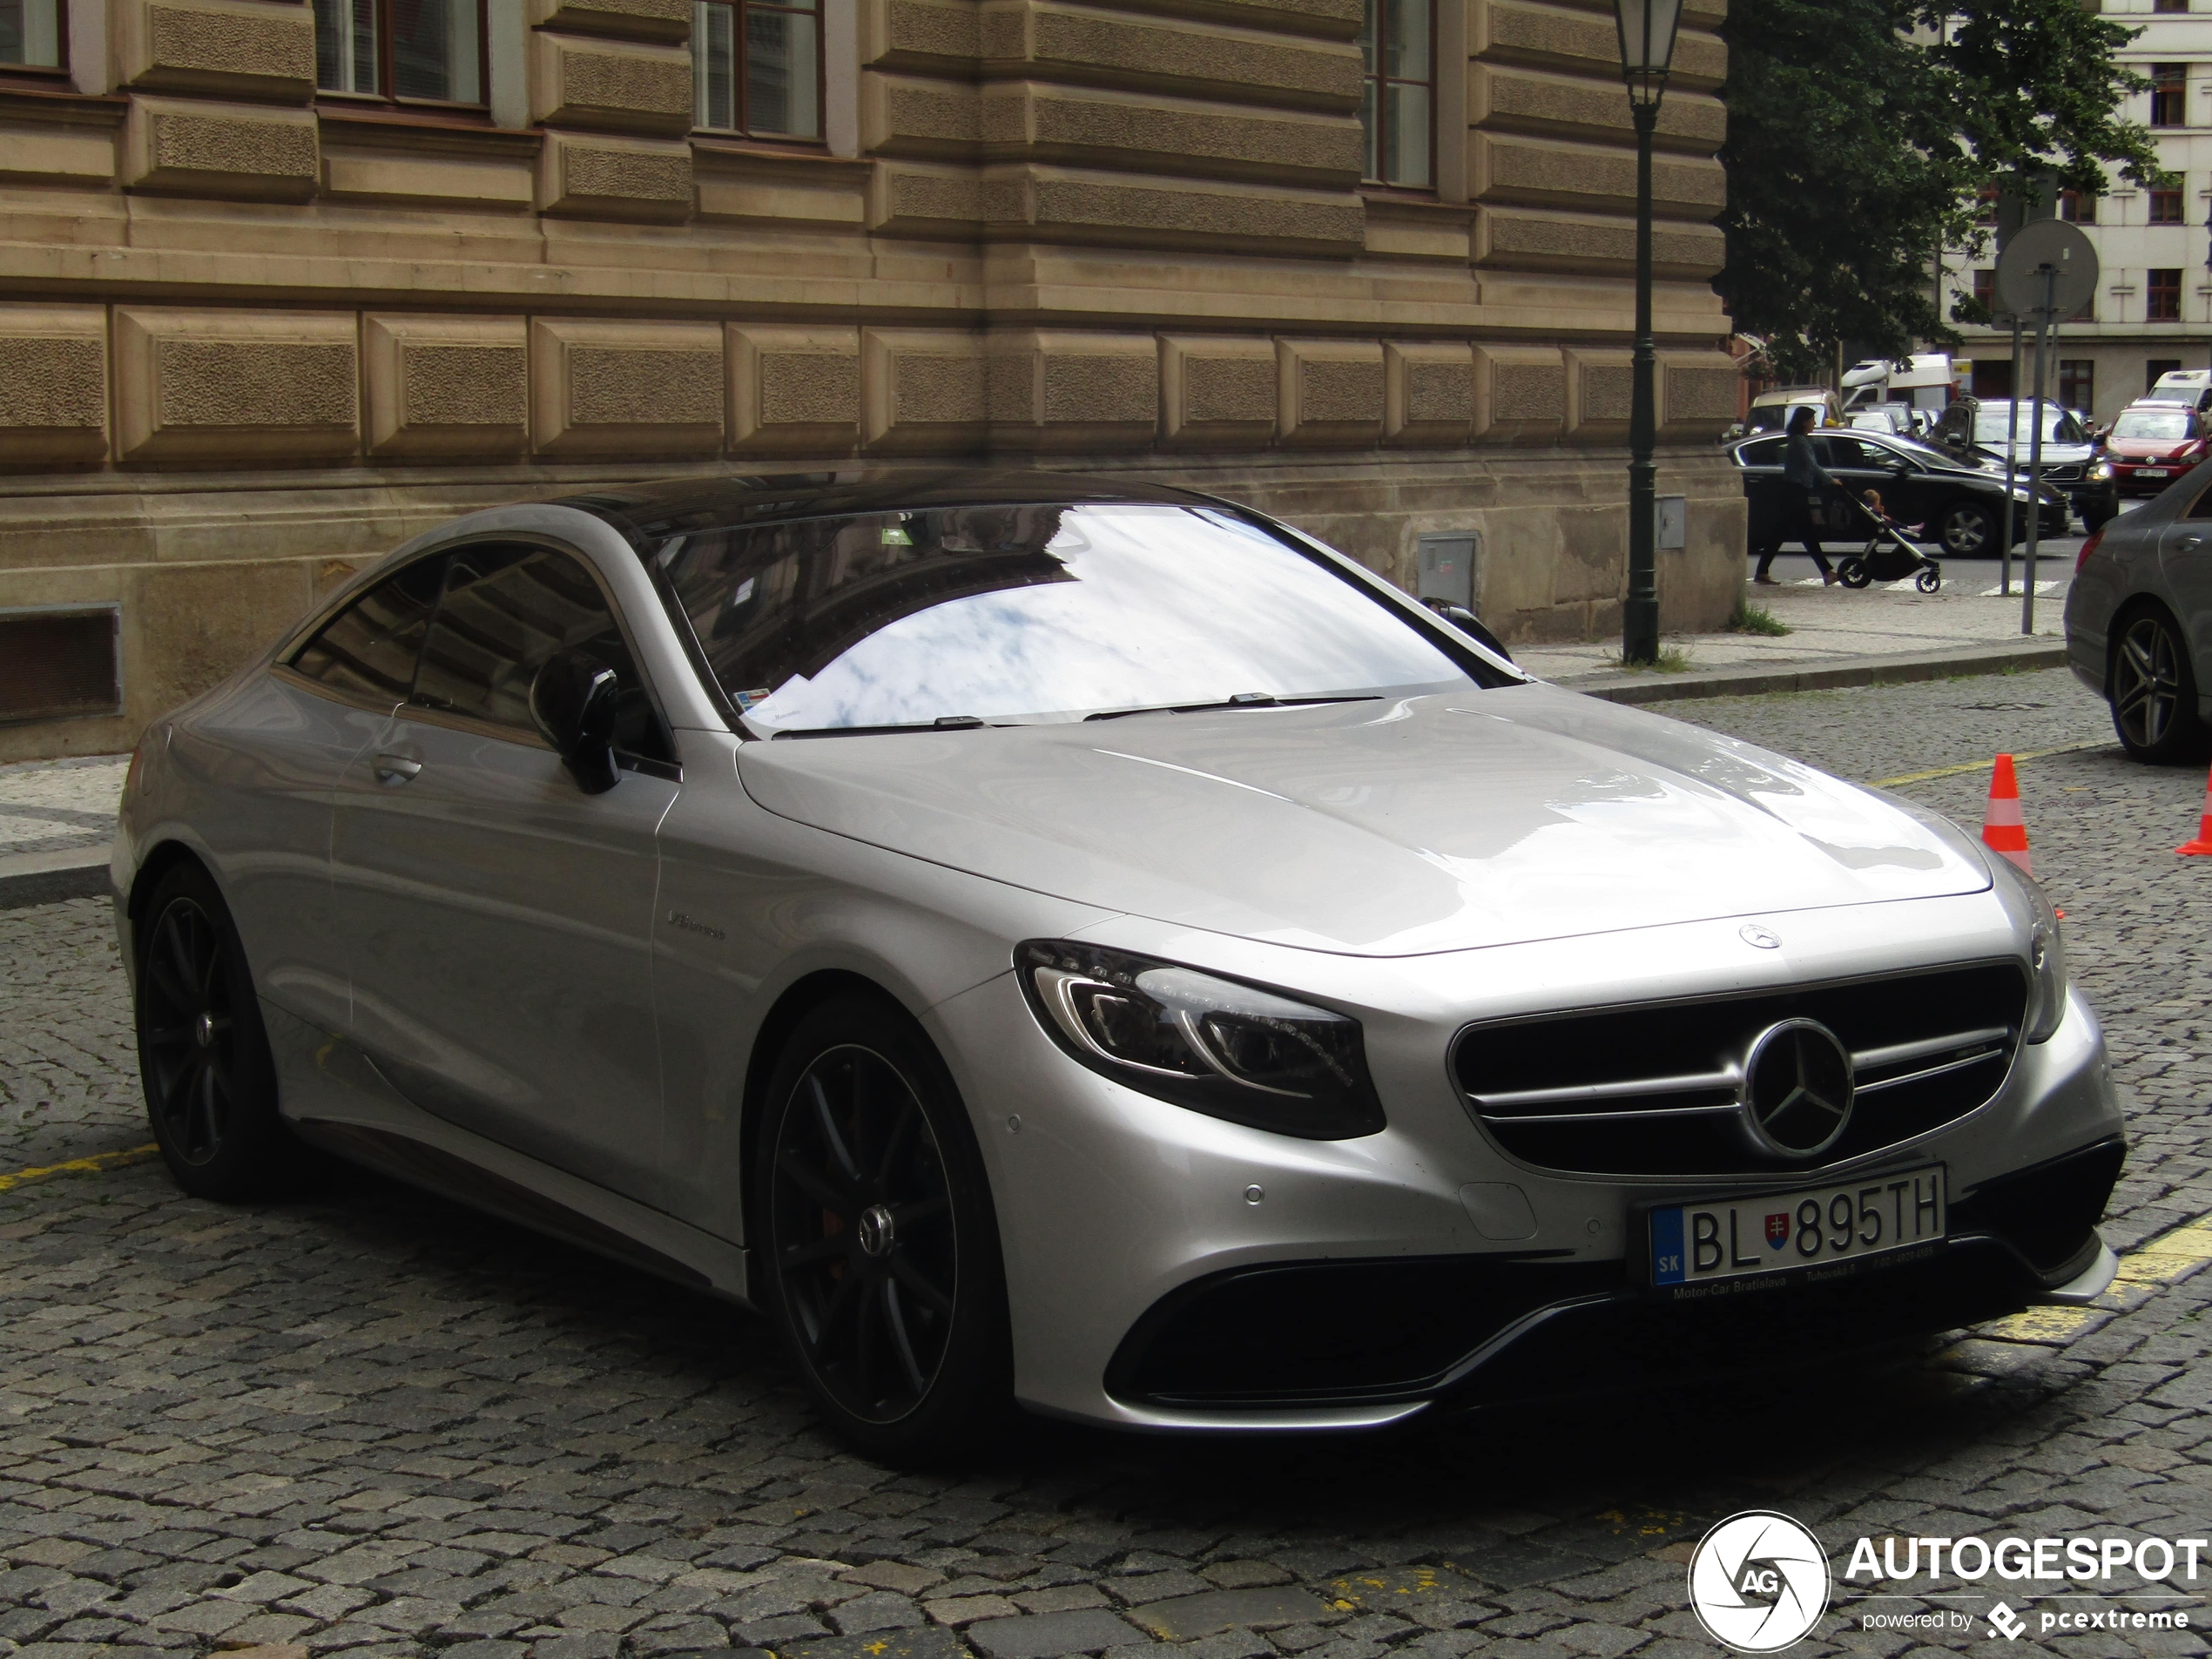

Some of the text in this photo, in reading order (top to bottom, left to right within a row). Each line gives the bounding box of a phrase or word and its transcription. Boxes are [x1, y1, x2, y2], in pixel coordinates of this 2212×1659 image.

[1692, 1175, 1939, 1272] BL 895TH
[1659, 1255, 1679, 1272] SK
[1674, 1284, 1730, 1299] Motor-Car
[1733, 1278, 1786, 1293] Bratislava
